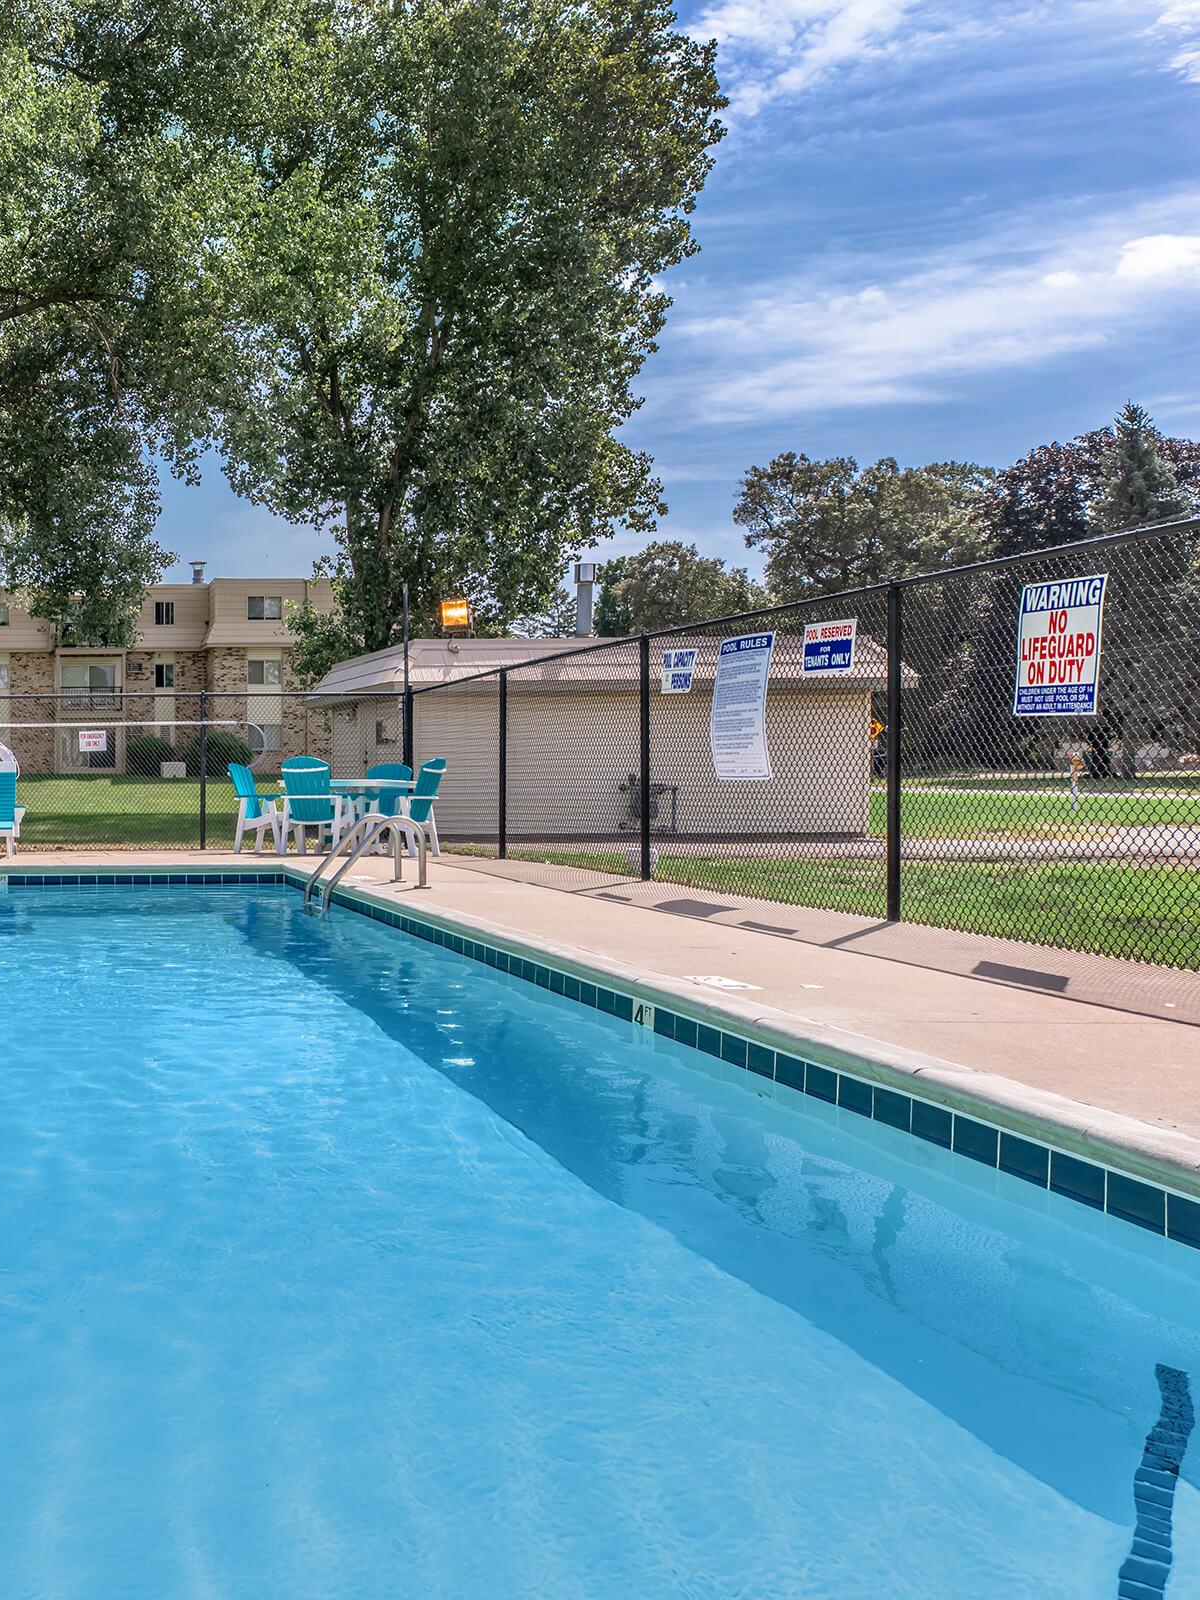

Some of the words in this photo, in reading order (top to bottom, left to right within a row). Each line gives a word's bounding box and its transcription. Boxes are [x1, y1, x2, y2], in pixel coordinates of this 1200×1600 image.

[1026, 579, 1101, 612] WARNING
[1048, 609, 1068, 634] NO
[806, 628, 818, 641] POOL
[820, 624, 853, 639] RESERVED
[722, 643, 738, 654] POOL
[740, 637, 768, 650] RULES
[1022, 632, 1095, 661] LIFEGUARD
[673, 650, 696, 669] CAPACITY
[805, 654, 829, 668] TENANTS
[831, 652, 850, 666] ONLY
[1027, 661, 1045, 685] ON
[1048, 658, 1085, 684] DUTY
[671, 672, 692, 690] PERSONS
[1018, 688, 1040, 696] CHILDREN
[1040, 687, 1057, 695] UNDER
[1057, 686, 1067, 694] THE
[1067, 686, 1078, 694] AGE
[1078, 685, 1086, 693] OF
[1021, 695, 1033, 703] MUST
[1034, 695, 1044, 703] NOT
[1055, 694, 1069, 702] POOL
[1069, 694, 1077, 702] OR
[1017, 703, 1036, 711] WITHOUT
[1042, 702, 1056, 710] ADULT
[1056, 702, 1062, 710] IN
[1062, 701, 1093, 710] ATTENDANCE
[634, 1004, 645, 1026] 4
[644, 1006, 652, 1017] FT
